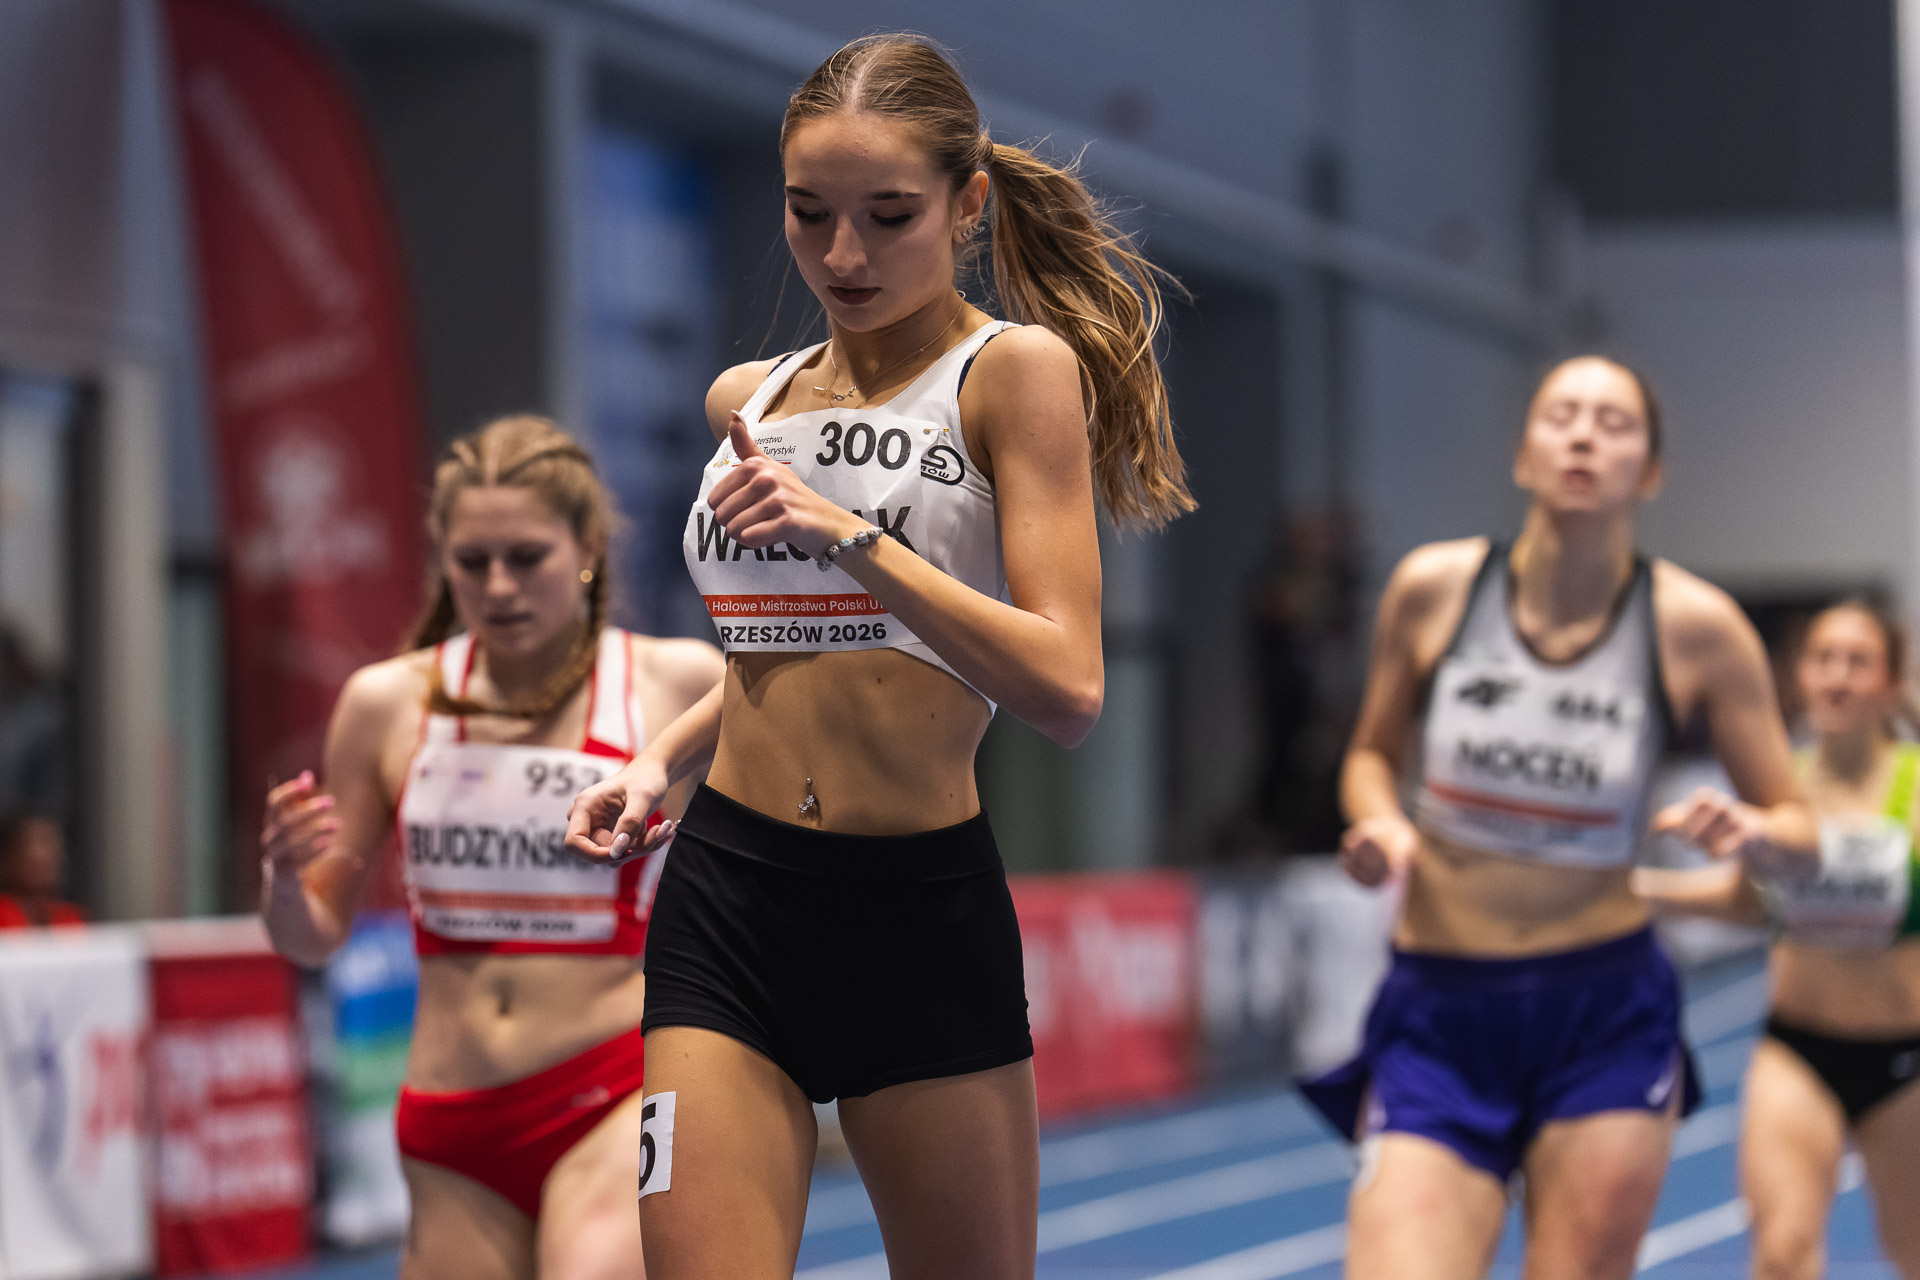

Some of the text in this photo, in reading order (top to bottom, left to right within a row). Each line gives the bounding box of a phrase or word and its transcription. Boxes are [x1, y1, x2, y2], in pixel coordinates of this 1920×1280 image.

[763, 445, 797, 456] Turystyki
[815, 421, 911, 470] 300
[712, 600, 757, 612] Halowe
[760, 600, 826, 612] Mistrzostwa
[829, 599, 867, 612] Polski
[869, 599, 883, 610] U
[720, 620, 887, 644] RZESZÓW 2026
